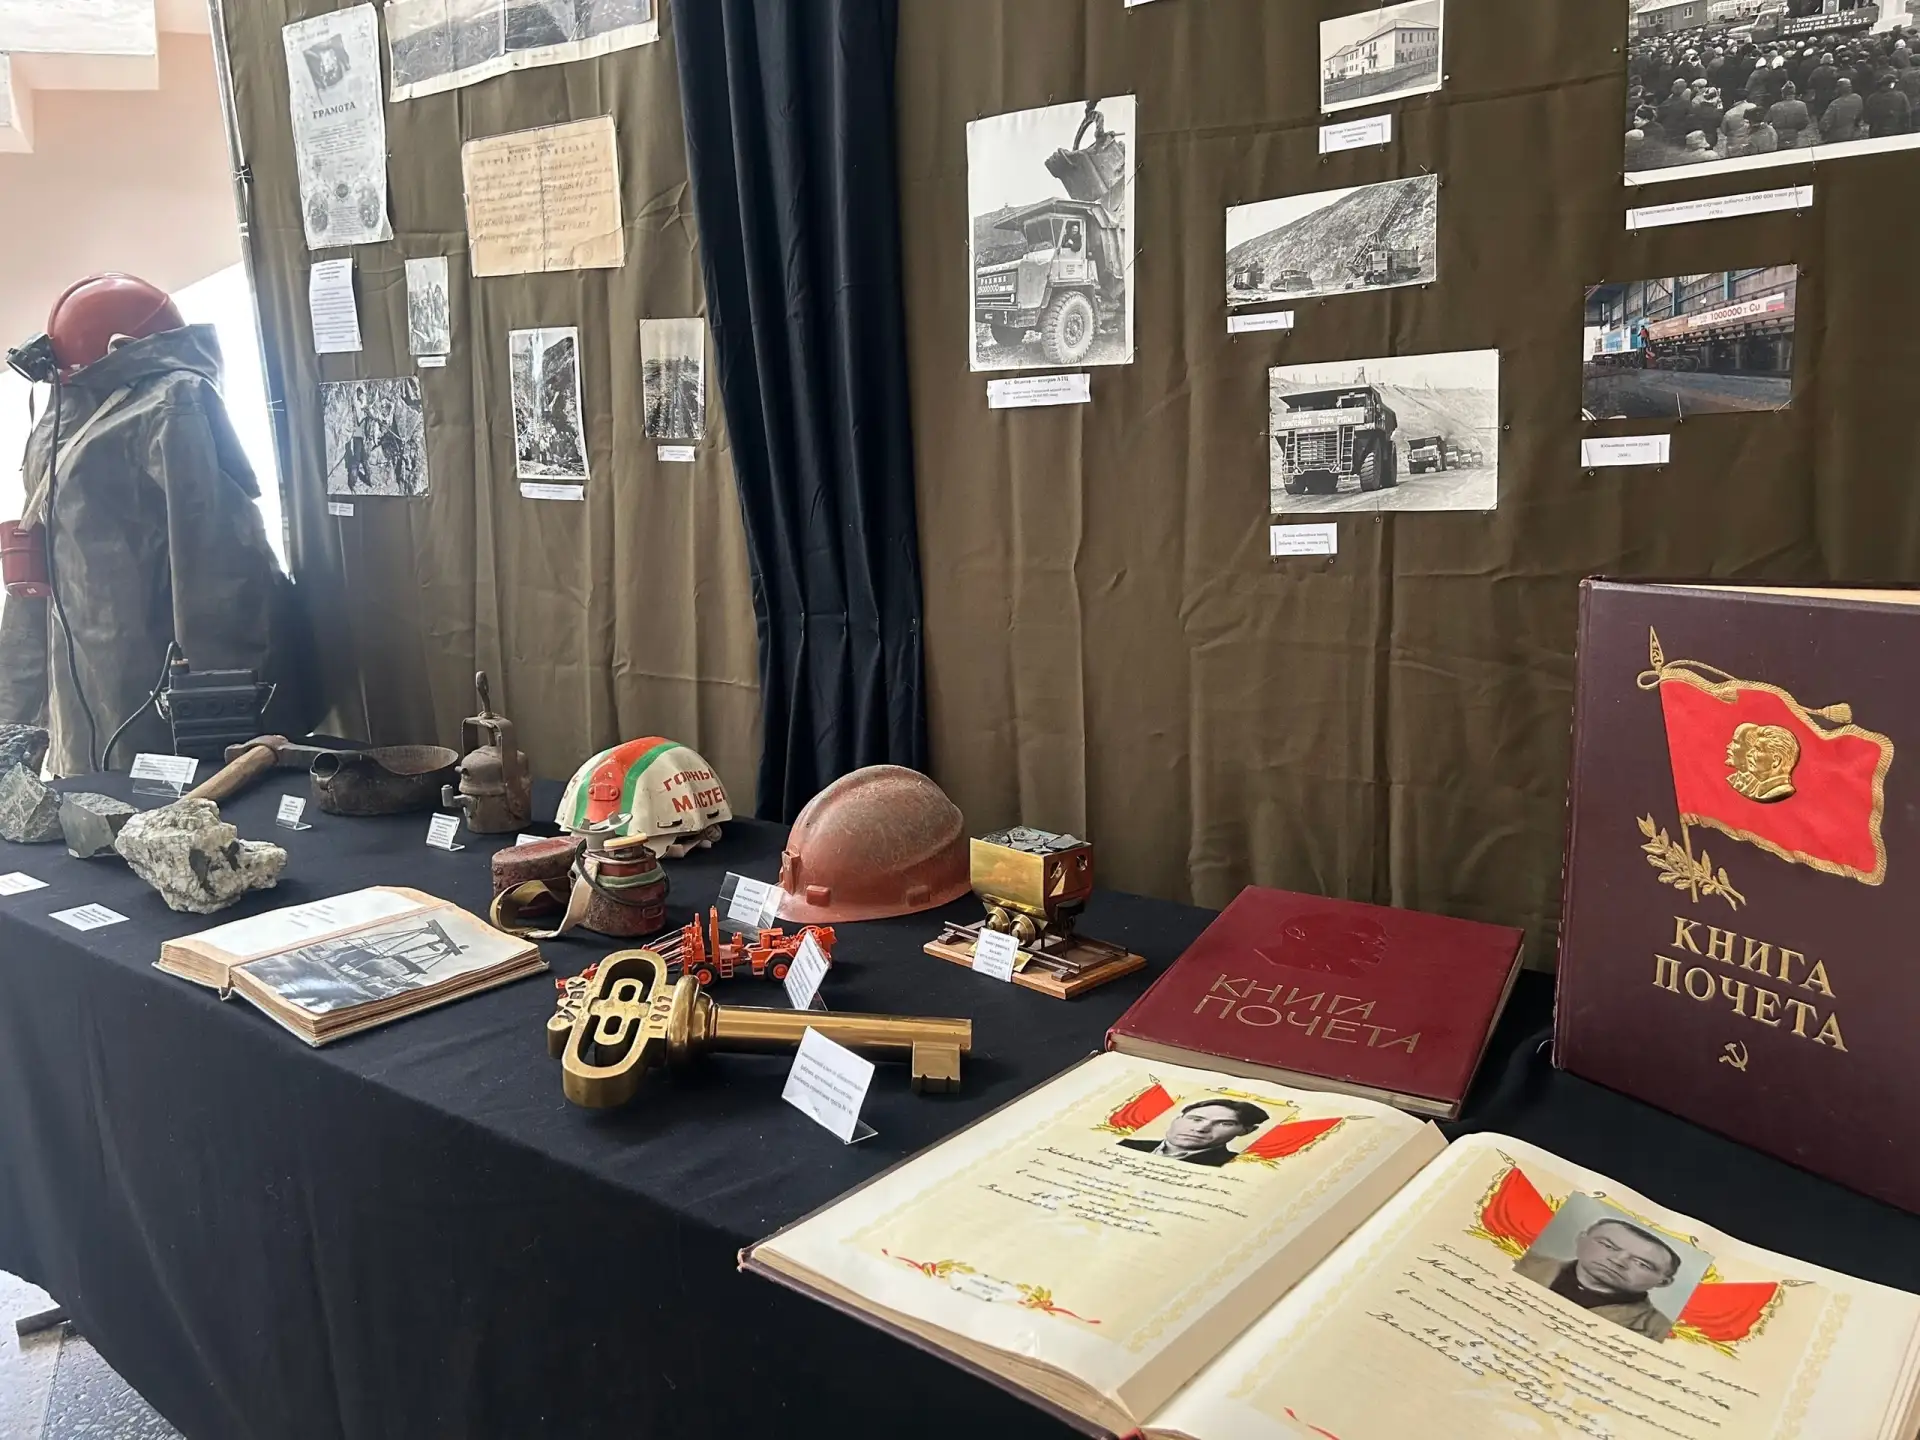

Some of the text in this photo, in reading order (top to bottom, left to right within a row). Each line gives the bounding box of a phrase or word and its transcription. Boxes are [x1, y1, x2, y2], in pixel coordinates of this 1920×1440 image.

[312, 101, 356, 119] ГРАМОТА
[663, 769, 714, 791] ГОРНЫ
[1670, 915, 1836, 998] КНИГА
[648, 995, 673, 1030] 1967
[1210, 973, 1377, 1020] КНИГА
[1652, 953, 1848, 1052] ПОЧЕТА
[1193, 994, 1421, 1053] ПОЧЕТА
